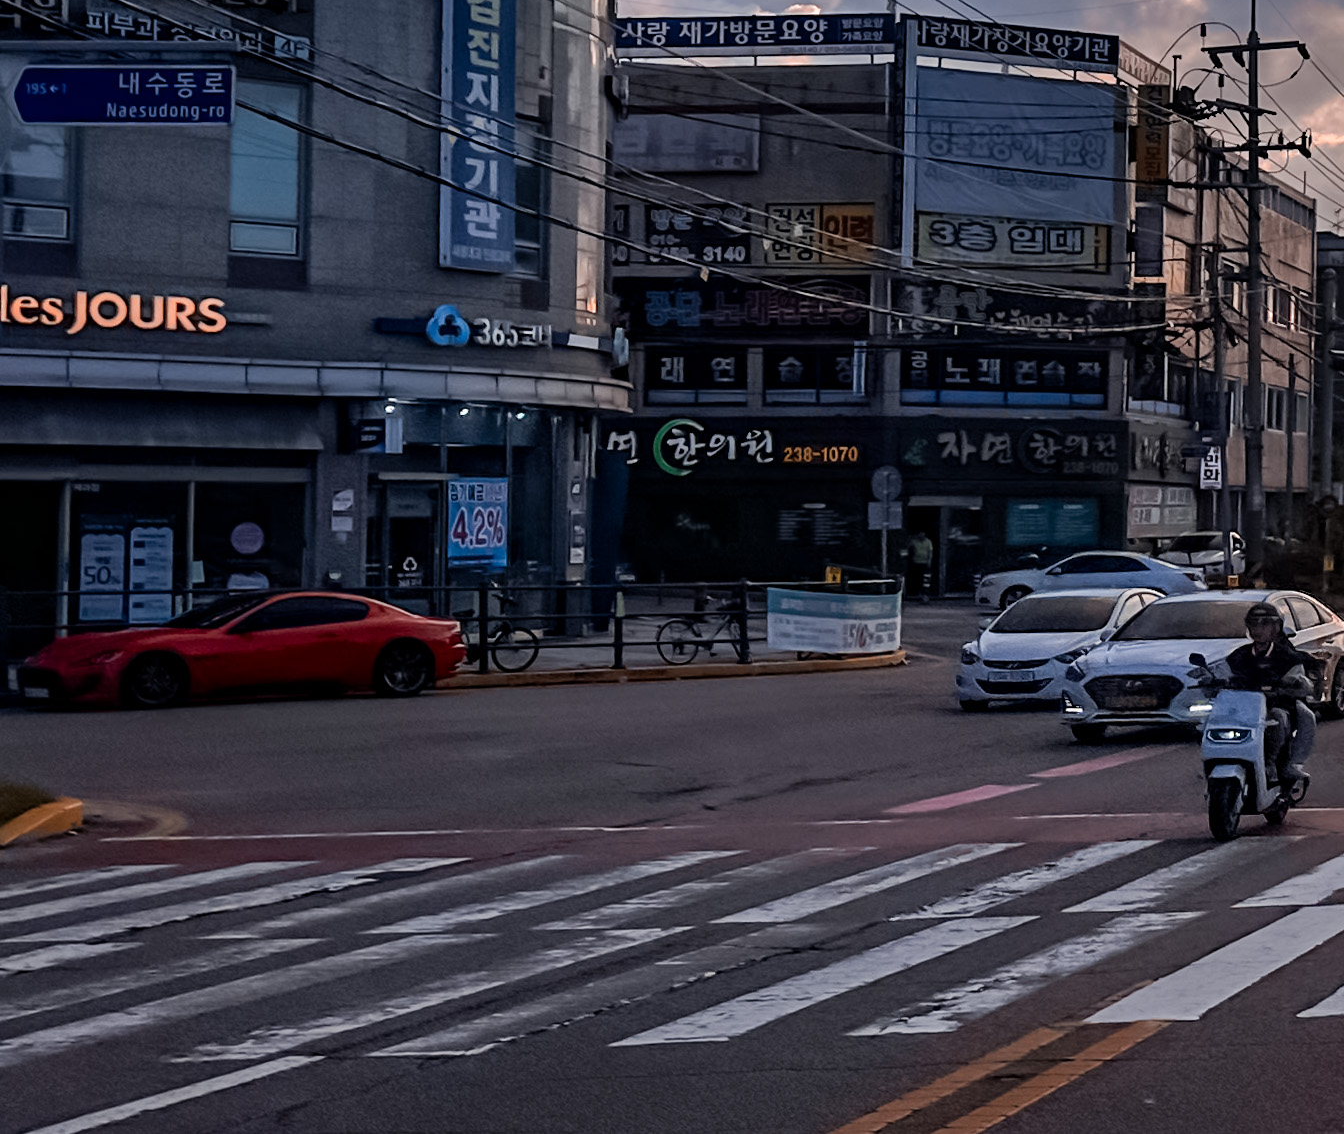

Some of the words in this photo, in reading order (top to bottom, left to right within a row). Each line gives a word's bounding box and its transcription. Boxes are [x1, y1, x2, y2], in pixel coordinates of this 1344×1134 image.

[620, 21, 671, 46] 사랑
[679, 19, 829, 45] 재가방문요양
[26, 82, 47, 95] 195
[118, 72, 226, 99] 내수동로
[106, 102, 226, 121] Naesudong-ro
[928, 221, 997, 253] 3층
[1009, 227, 1085, 255] 임대
[703, 246, 747, 263] 3140
[0, 285, 65, 326] les
[67, 291, 228, 334] JOURS
[666, 428, 775, 466] 한의원
[783, 446, 860, 464] 238-1070
[937, 429, 1015, 467] 자연
[1029, 429, 1118, 467] 한의원
[452, 508, 504, 547] 4.2%
